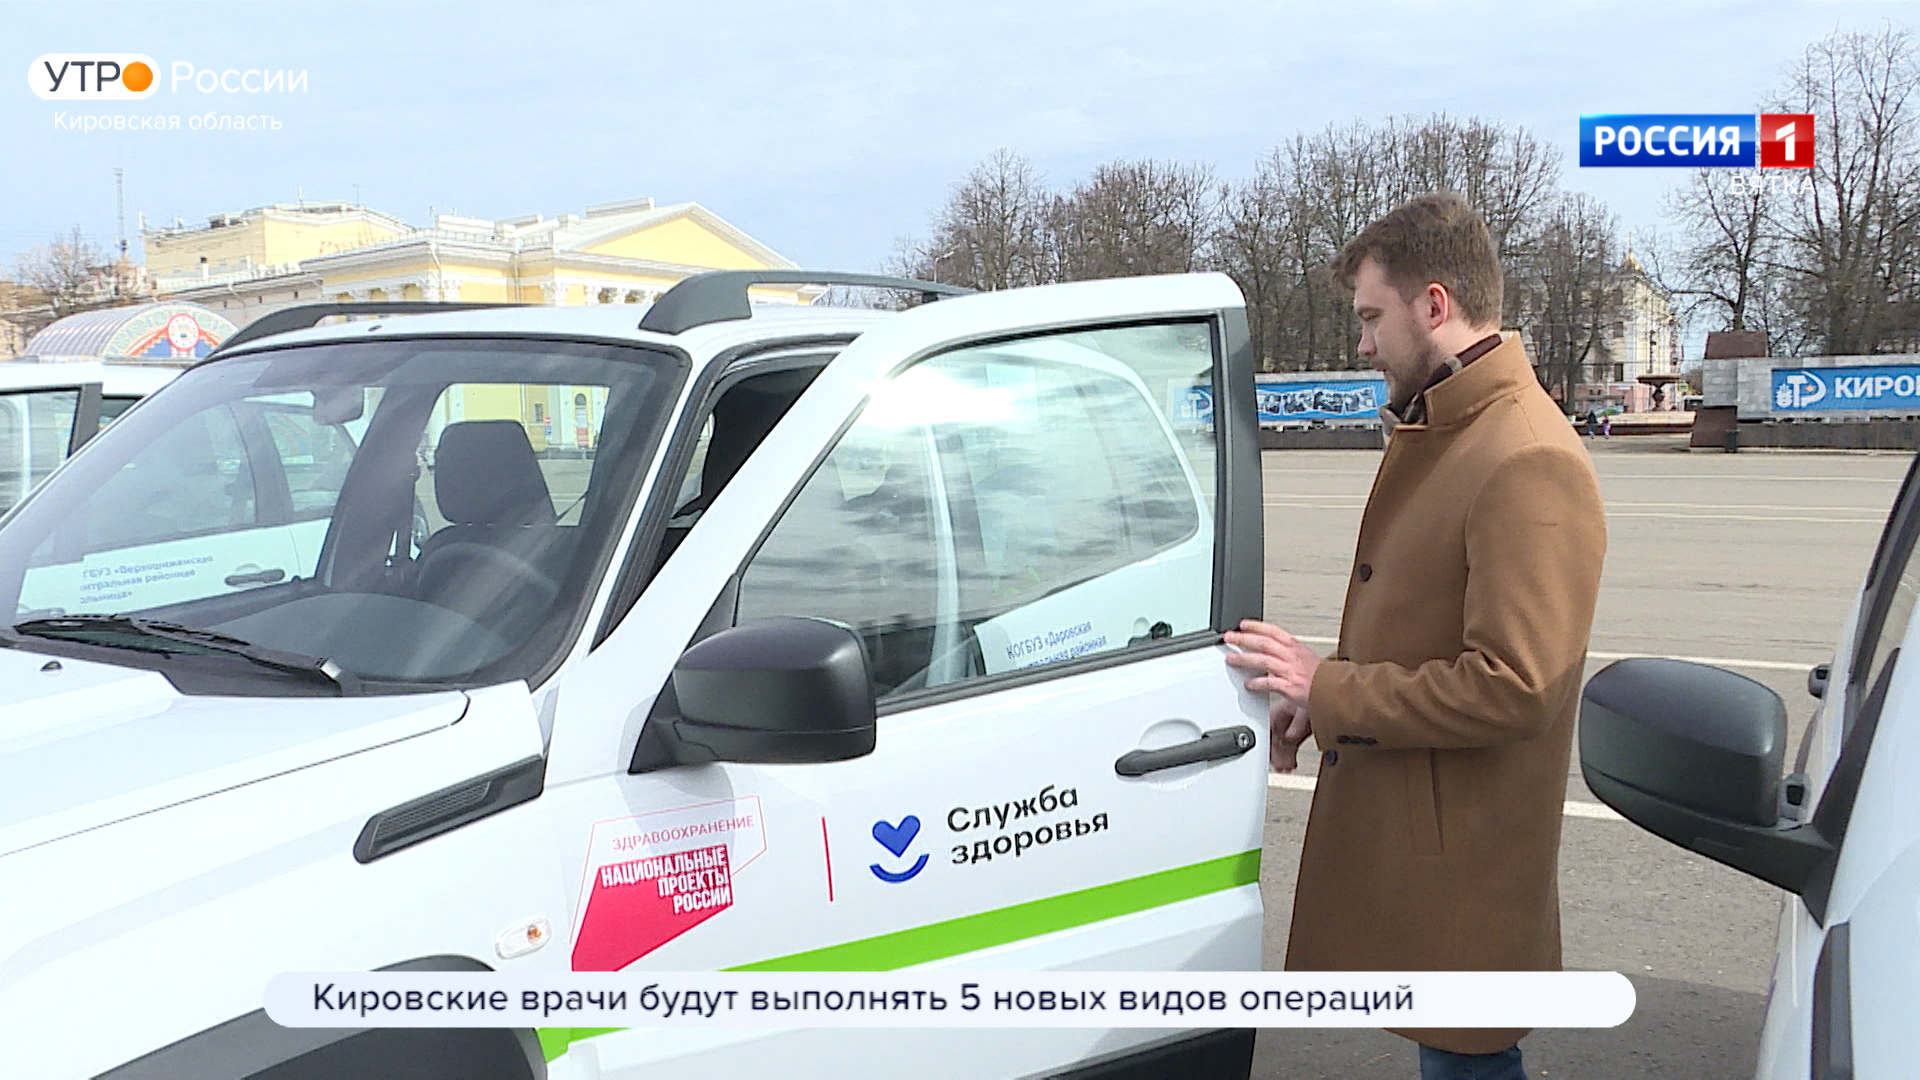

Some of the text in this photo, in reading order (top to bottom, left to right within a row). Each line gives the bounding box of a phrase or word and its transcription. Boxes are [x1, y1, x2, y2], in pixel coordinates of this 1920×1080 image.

[1006, 635, 1044, 660] КОГБУЗ
[947, 784, 1079, 832] Служба
[612, 815, 754, 851] ЗДРАВООХРАНЕНИЕ
[951, 812, 1109, 865] здоровья
[601, 846, 727, 888] НАЦИОНАЛЬНЫЕ
[657, 867, 729, 898] ПРОЕКТЫ
[673, 887, 731, 915] РОССИИ
